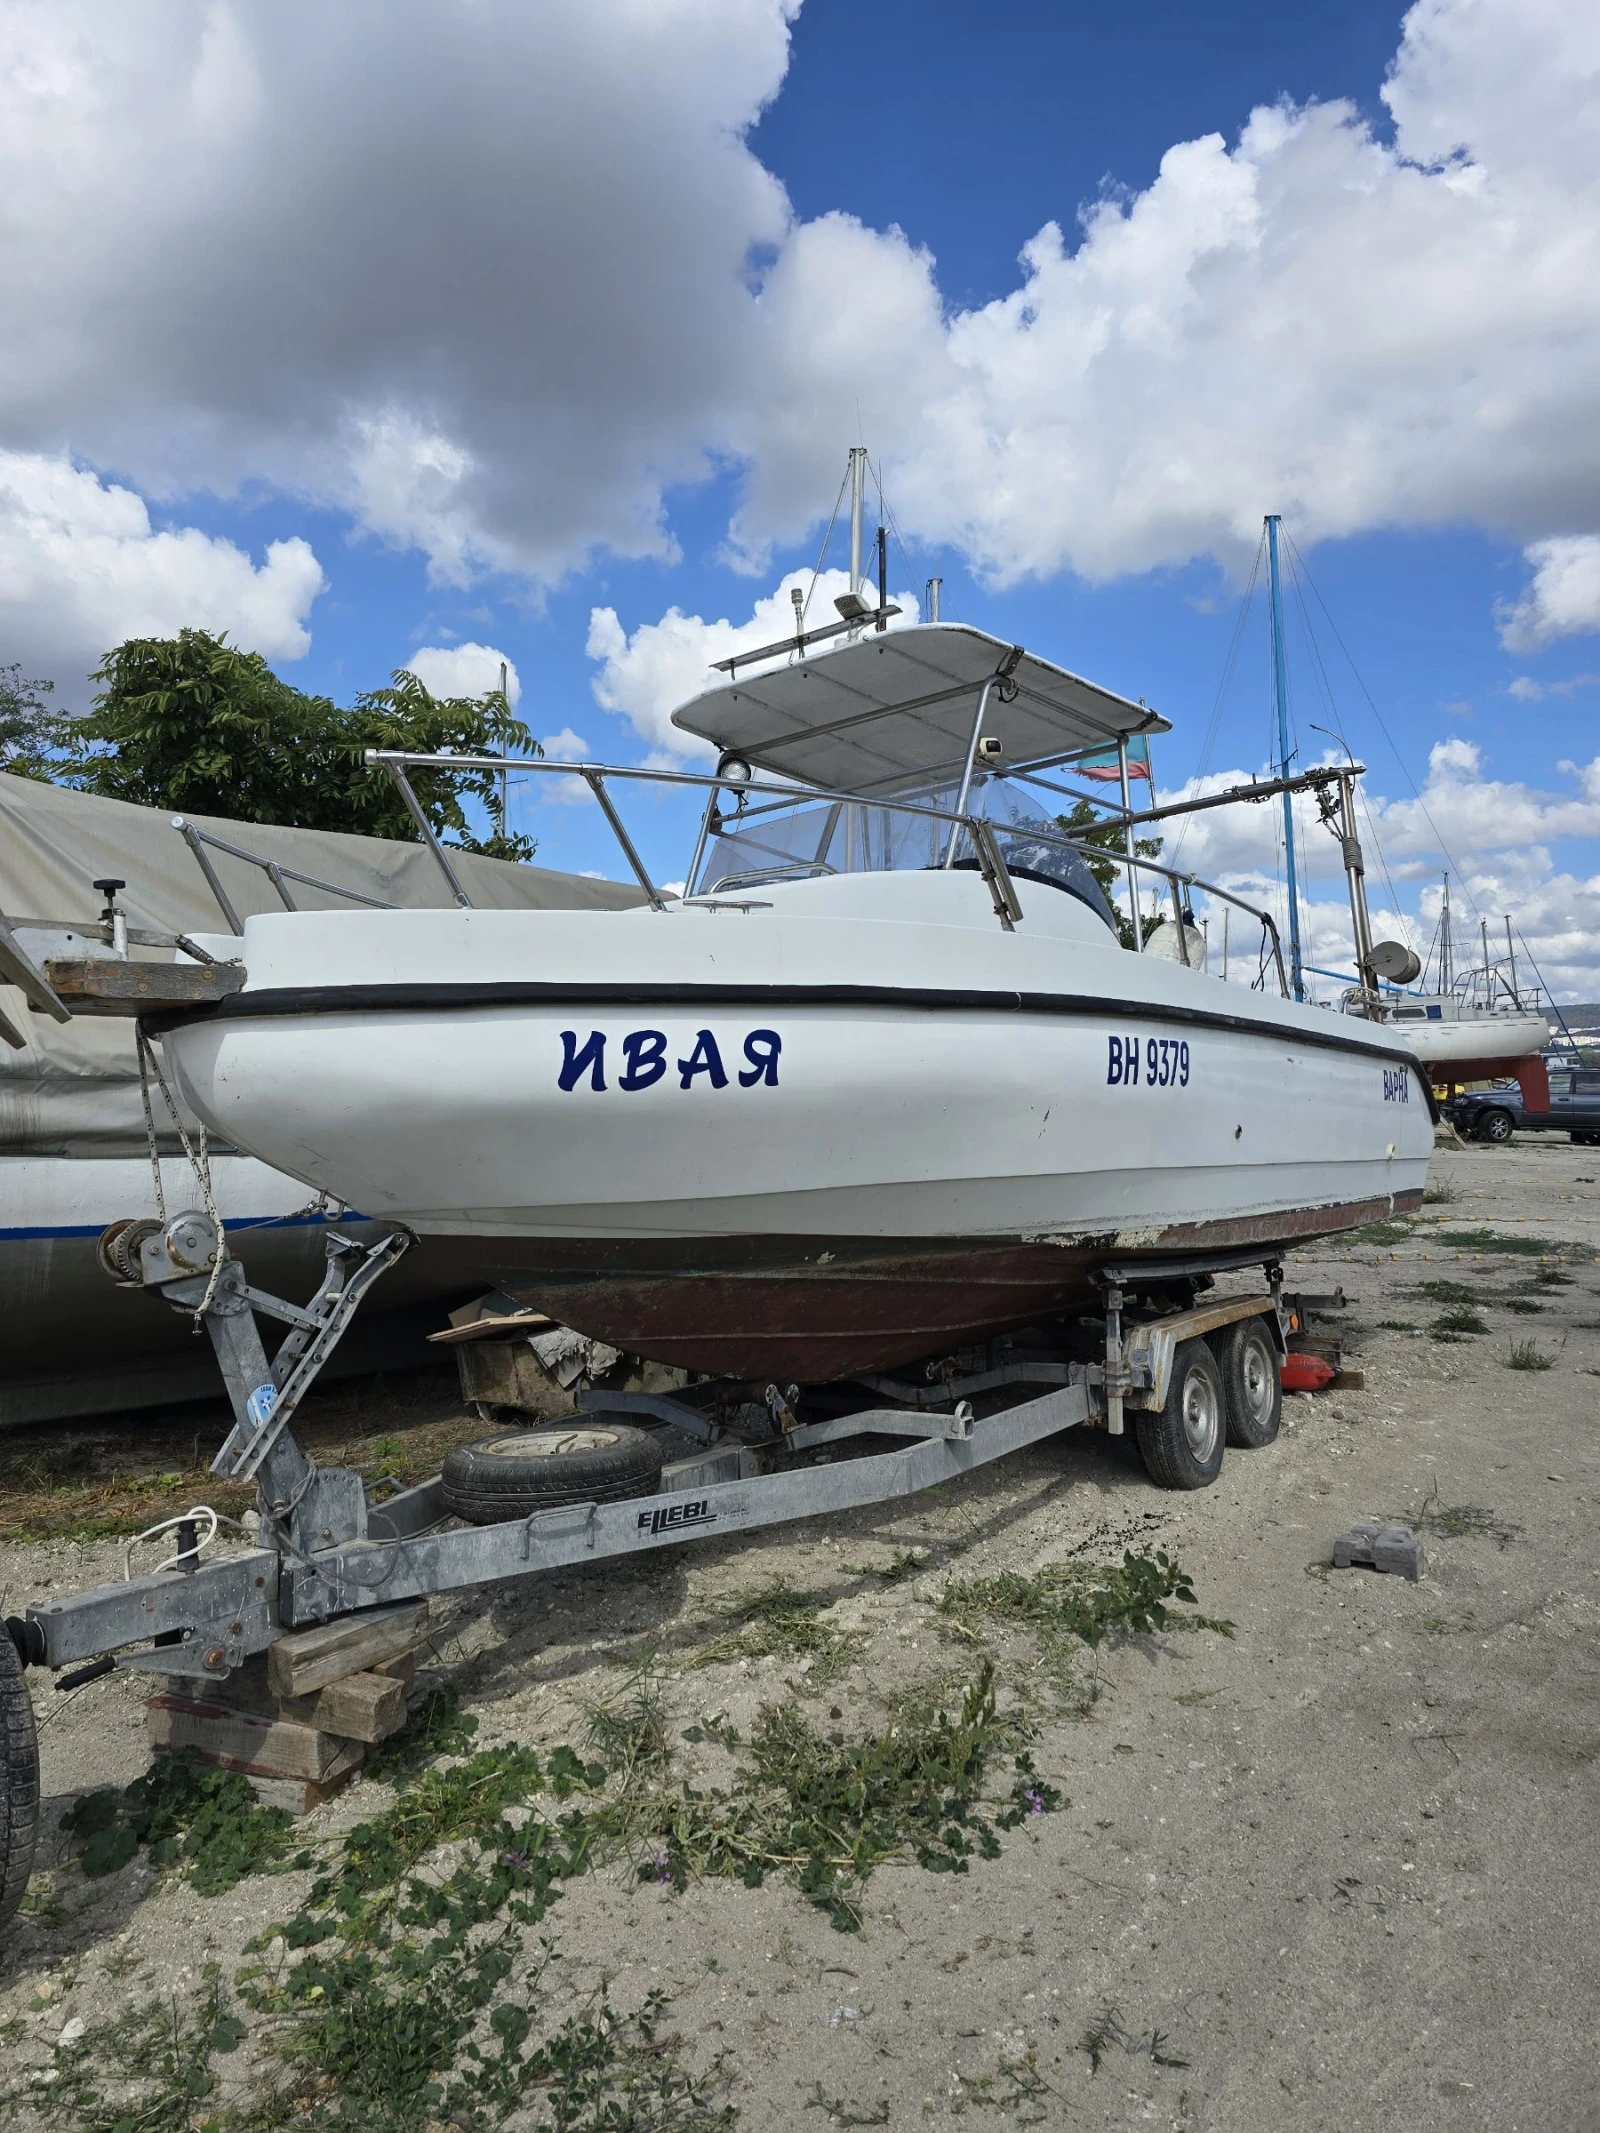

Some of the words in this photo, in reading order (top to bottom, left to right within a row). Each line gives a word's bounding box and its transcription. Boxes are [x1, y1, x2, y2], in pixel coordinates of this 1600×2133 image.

[557, 1029, 782, 1092] ИВАЯ
[1146, 1038, 1190, 1087] 9379
[1383, 1069, 1409, 1104] ВАРНА
[637, 1500, 717, 1535] ELLEBI
